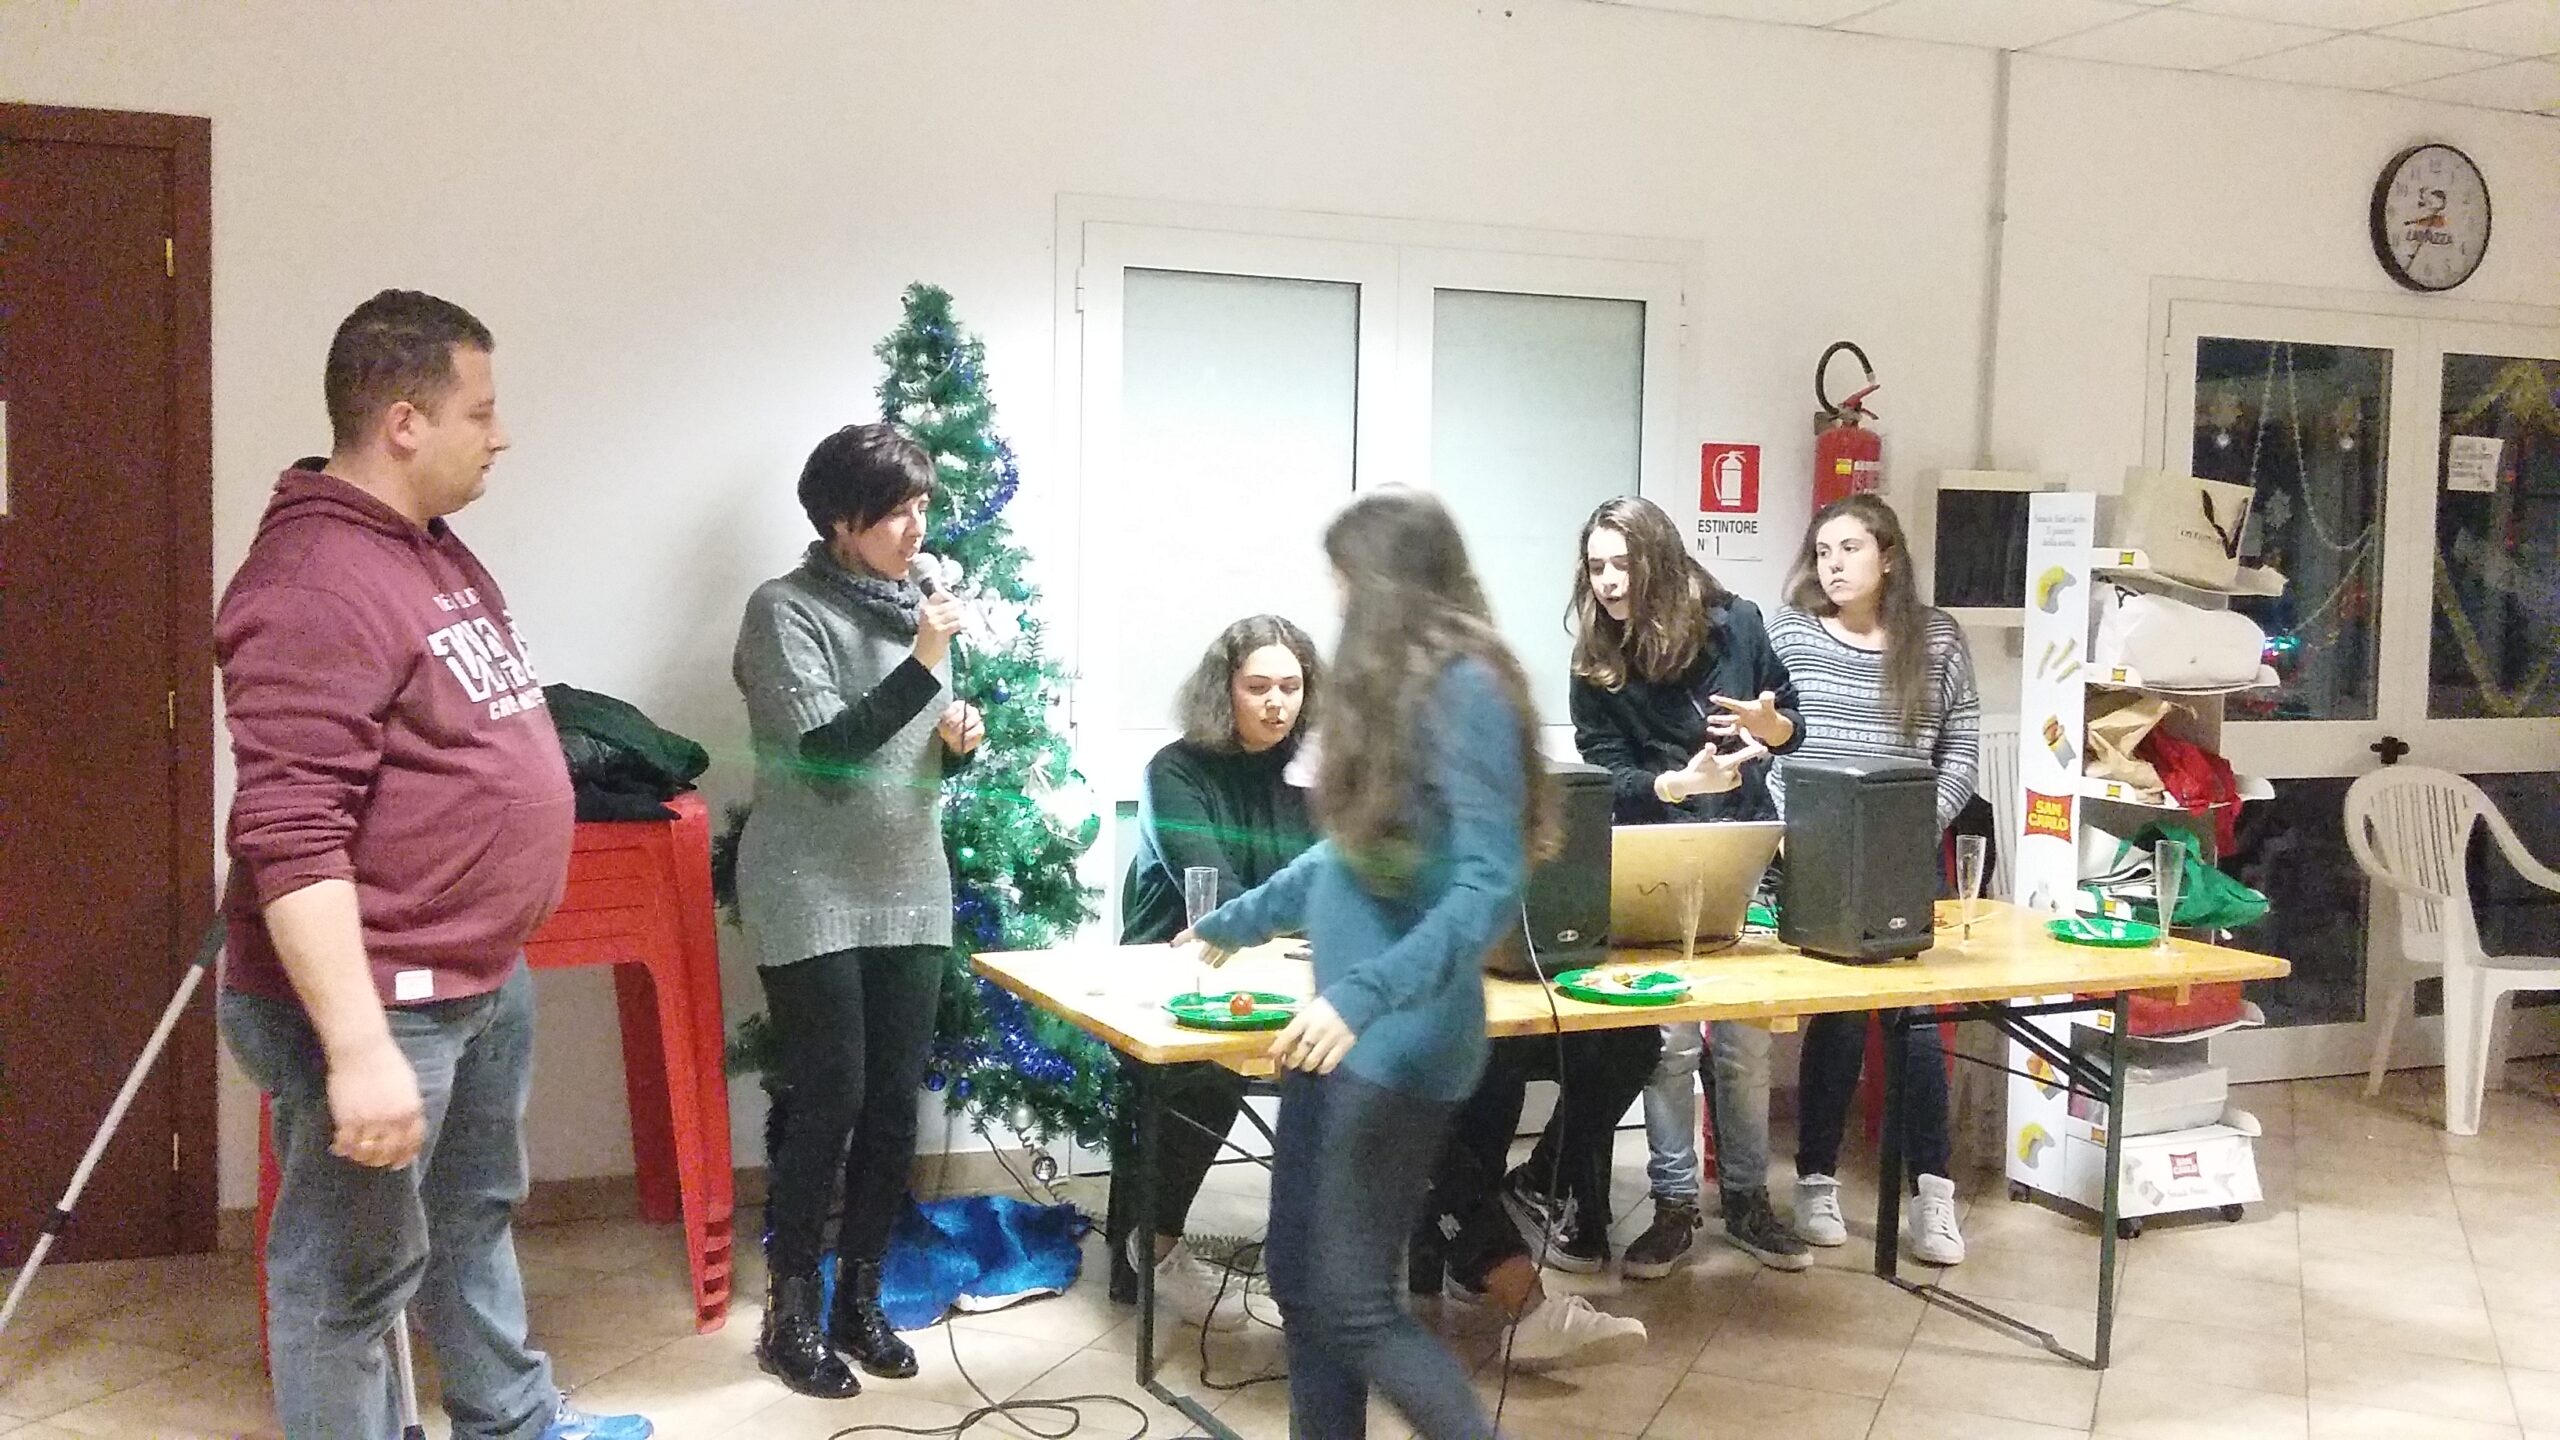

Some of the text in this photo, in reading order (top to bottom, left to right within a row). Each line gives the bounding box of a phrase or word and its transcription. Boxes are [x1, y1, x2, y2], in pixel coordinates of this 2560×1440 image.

[1697, 519, 1759, 534] ESTINTORE
[1715, 535, 1720, 556] 1
[2036, 799, 2062, 817] SAN
[2028, 812, 2069, 831] CARLO
[2176, 1157, 2192, 1168] SAN
